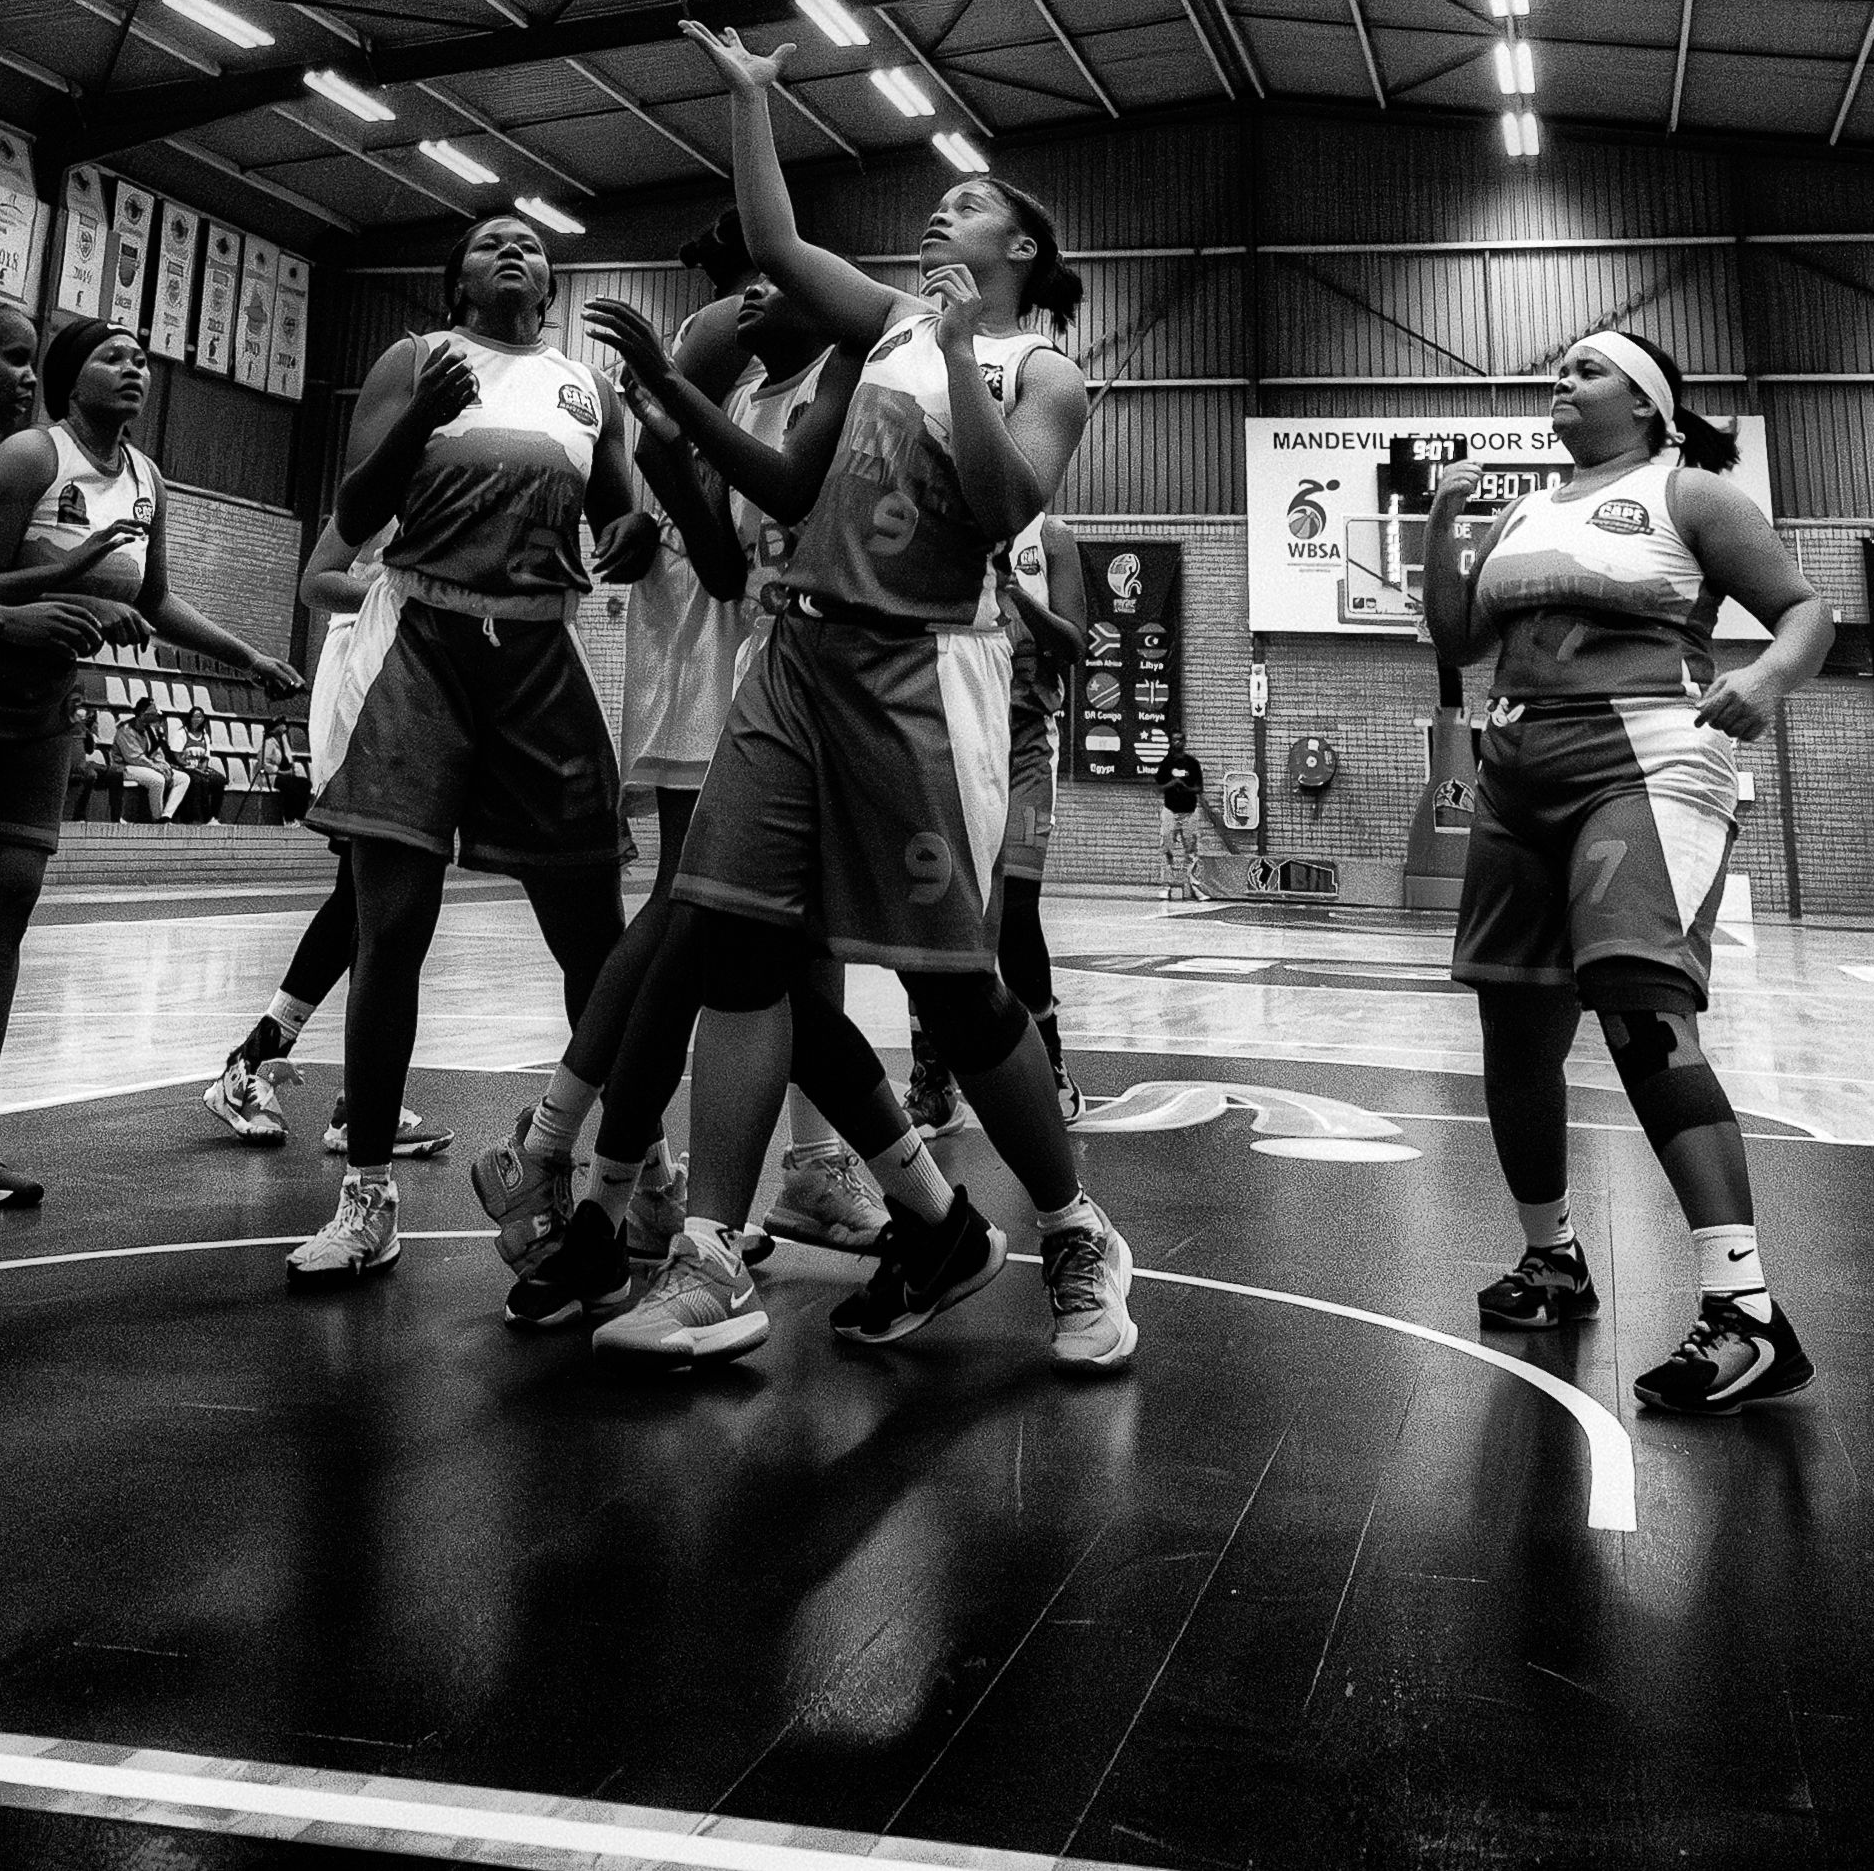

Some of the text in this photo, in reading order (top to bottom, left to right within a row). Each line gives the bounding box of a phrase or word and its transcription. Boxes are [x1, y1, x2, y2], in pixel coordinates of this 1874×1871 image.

[1413, 440, 1455, 460] 9:07
[1598, 504, 1645, 525] CAPE
[865, 490, 919, 557] 9
[1288, 543, 1341, 559] WBSA
[1140, 661, 1164, 671] Libya
[1085, 711, 1122, 721] DR Congo
[1138, 711, 1165, 721] Kenya
[1090, 764, 1115, 774] Egypt
[1137, 765, 1159, 774] Liber
[905, 831, 952, 906] 9
[1586, 840, 1627, 905] 7
